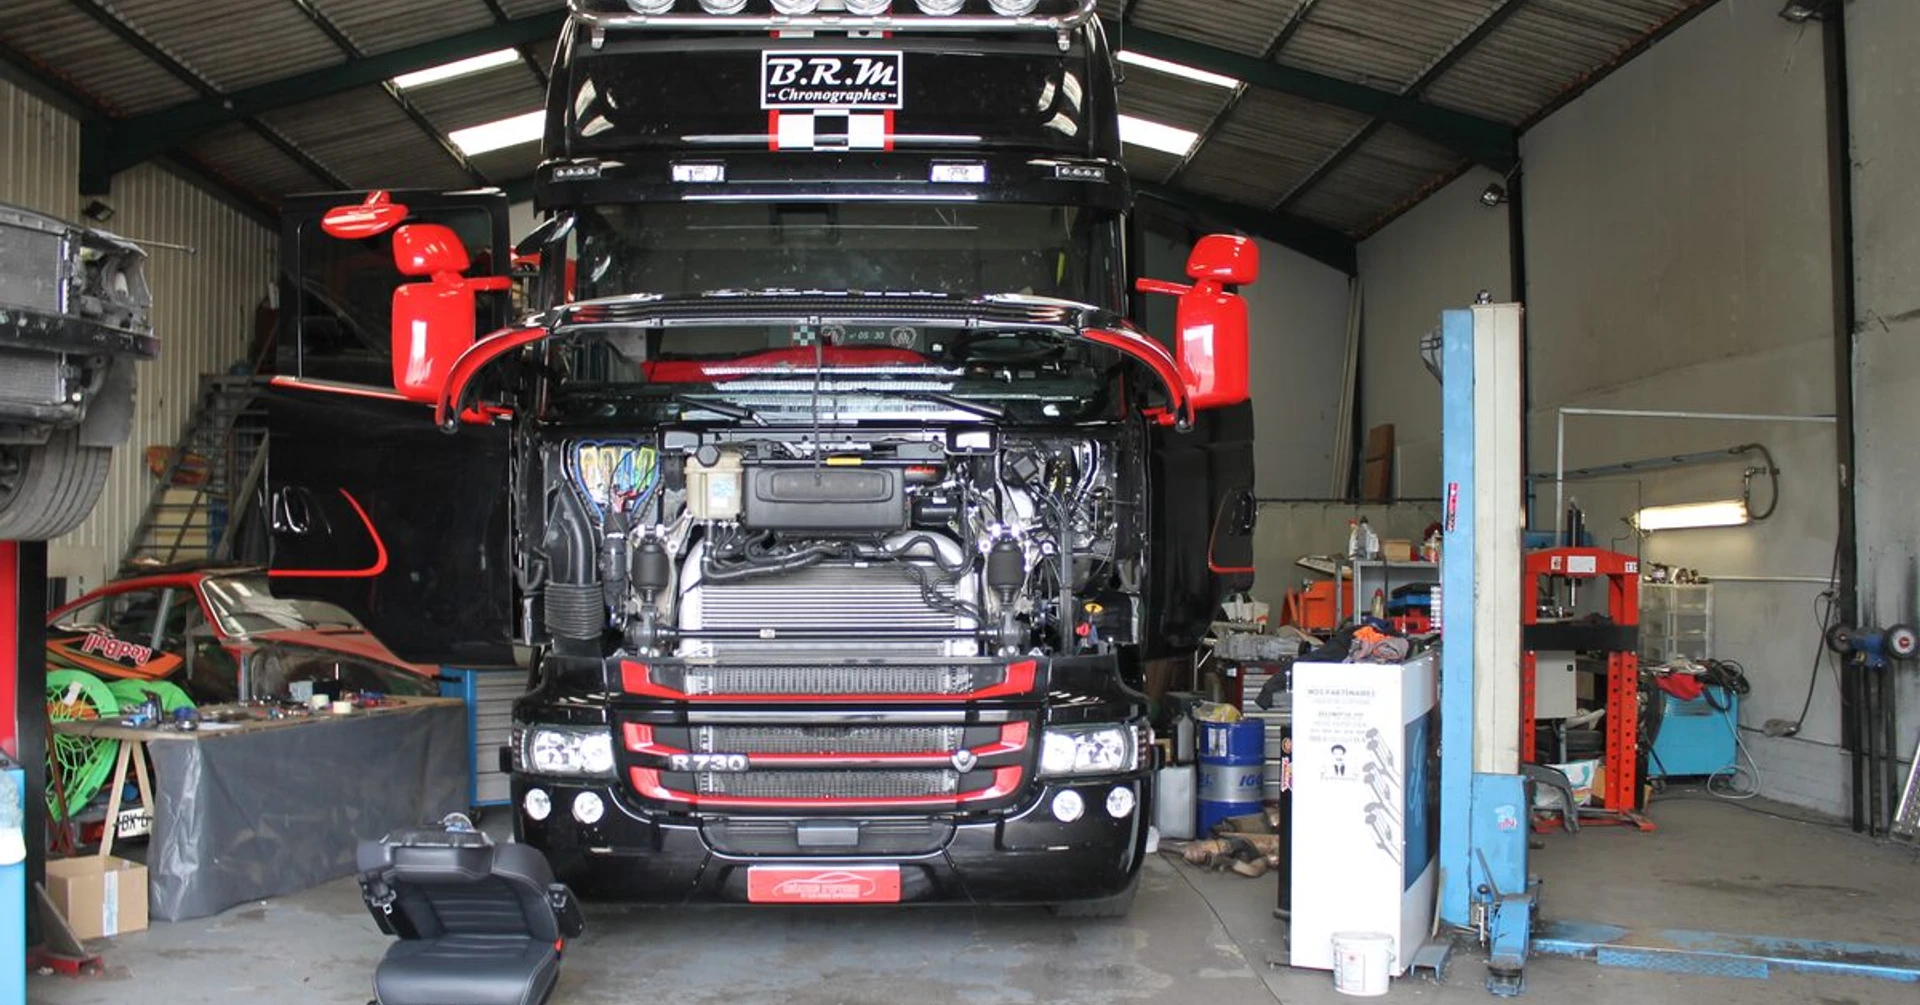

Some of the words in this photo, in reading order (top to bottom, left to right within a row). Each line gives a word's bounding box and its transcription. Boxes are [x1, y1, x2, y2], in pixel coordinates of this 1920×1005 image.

[767, 58, 897, 86] B.R.M
[778, 88, 887, 104] Chronographes
[671, 754, 689, 771] R
[692, 754, 746, 771] 730
